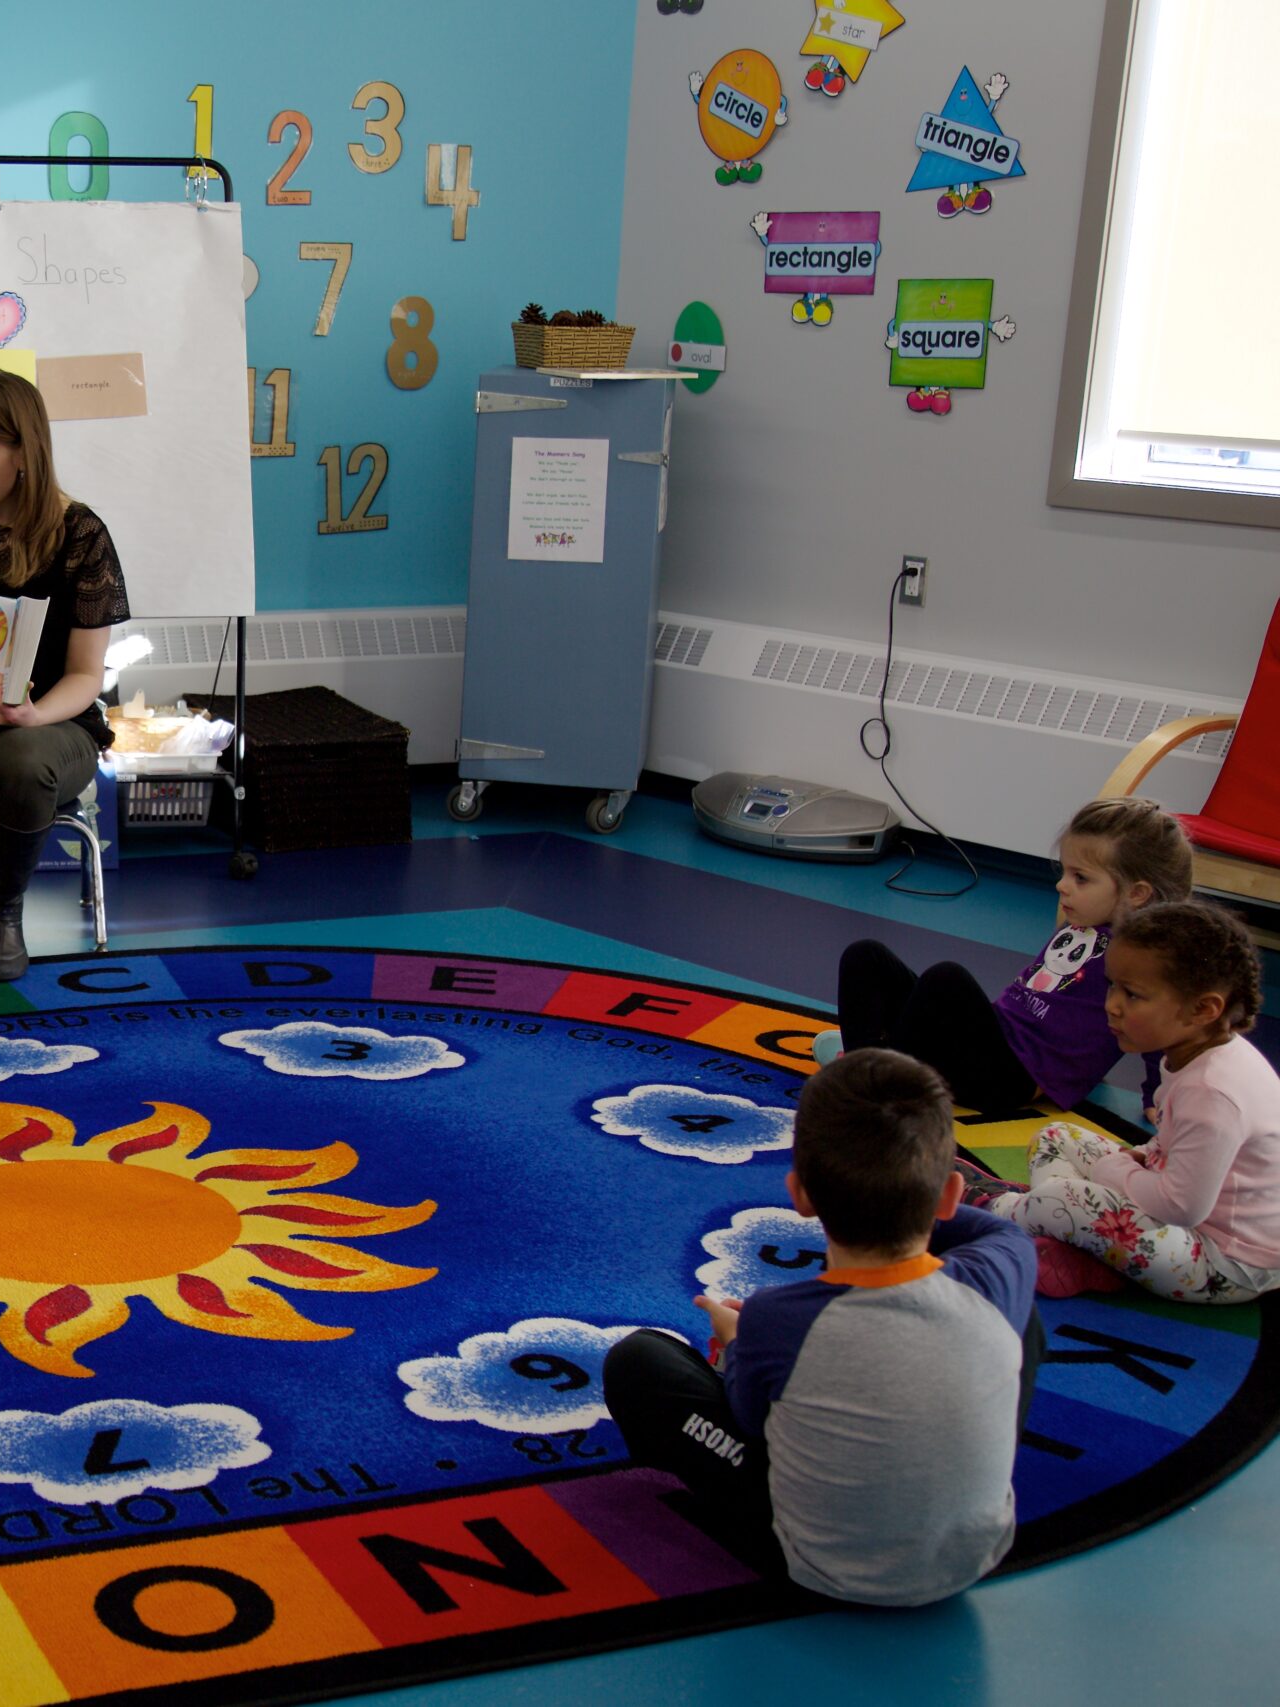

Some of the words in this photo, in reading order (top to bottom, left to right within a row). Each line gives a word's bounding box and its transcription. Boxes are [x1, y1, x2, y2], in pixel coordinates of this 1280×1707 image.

[842, 24, 865, 39] star
[187, 84, 220, 179] 1
[348, 81, 406, 174] 3
[714, 88, 764, 128] circle
[48, 111, 110, 201] 0
[266, 110, 313, 206] 2
[922, 117, 1010, 164] triangle
[426, 144, 480, 240] 4
[17, 234, 126, 304] Shapes
[768, 246, 872, 274] rectangle
[300, 242, 353, 336] 7
[387, 296, 438, 390] 8
[691, 349, 712, 364] oval
[900, 327, 980, 356] square
[318, 442, 388, 536] 12
[57, 966, 150, 995] C
[246, 961, 333, 986] D
[429, 966, 498, 995] E
[606, 992, 692, 1017] F
[112, 1008, 150, 1022] is
[169, 1006, 243, 1021] the
[264, 1006, 542, 1036] everlasting
[568, 1028, 674, 1060] God,
[698, 1057, 772, 1084] the
[322, 1039, 372, 1061] 3
[666, 1114, 735, 1132] 4
[758, 1244, 828, 1271] 5
[1040, 1323, 1197, 1395] K
[83, 1429, 152, 1476] 7
[512, 1428, 608, 1464] 28
[247, 1462, 397, 1504] The
[358, 1516, 570, 1615] N
[93, 1564, 276, 1653] O
